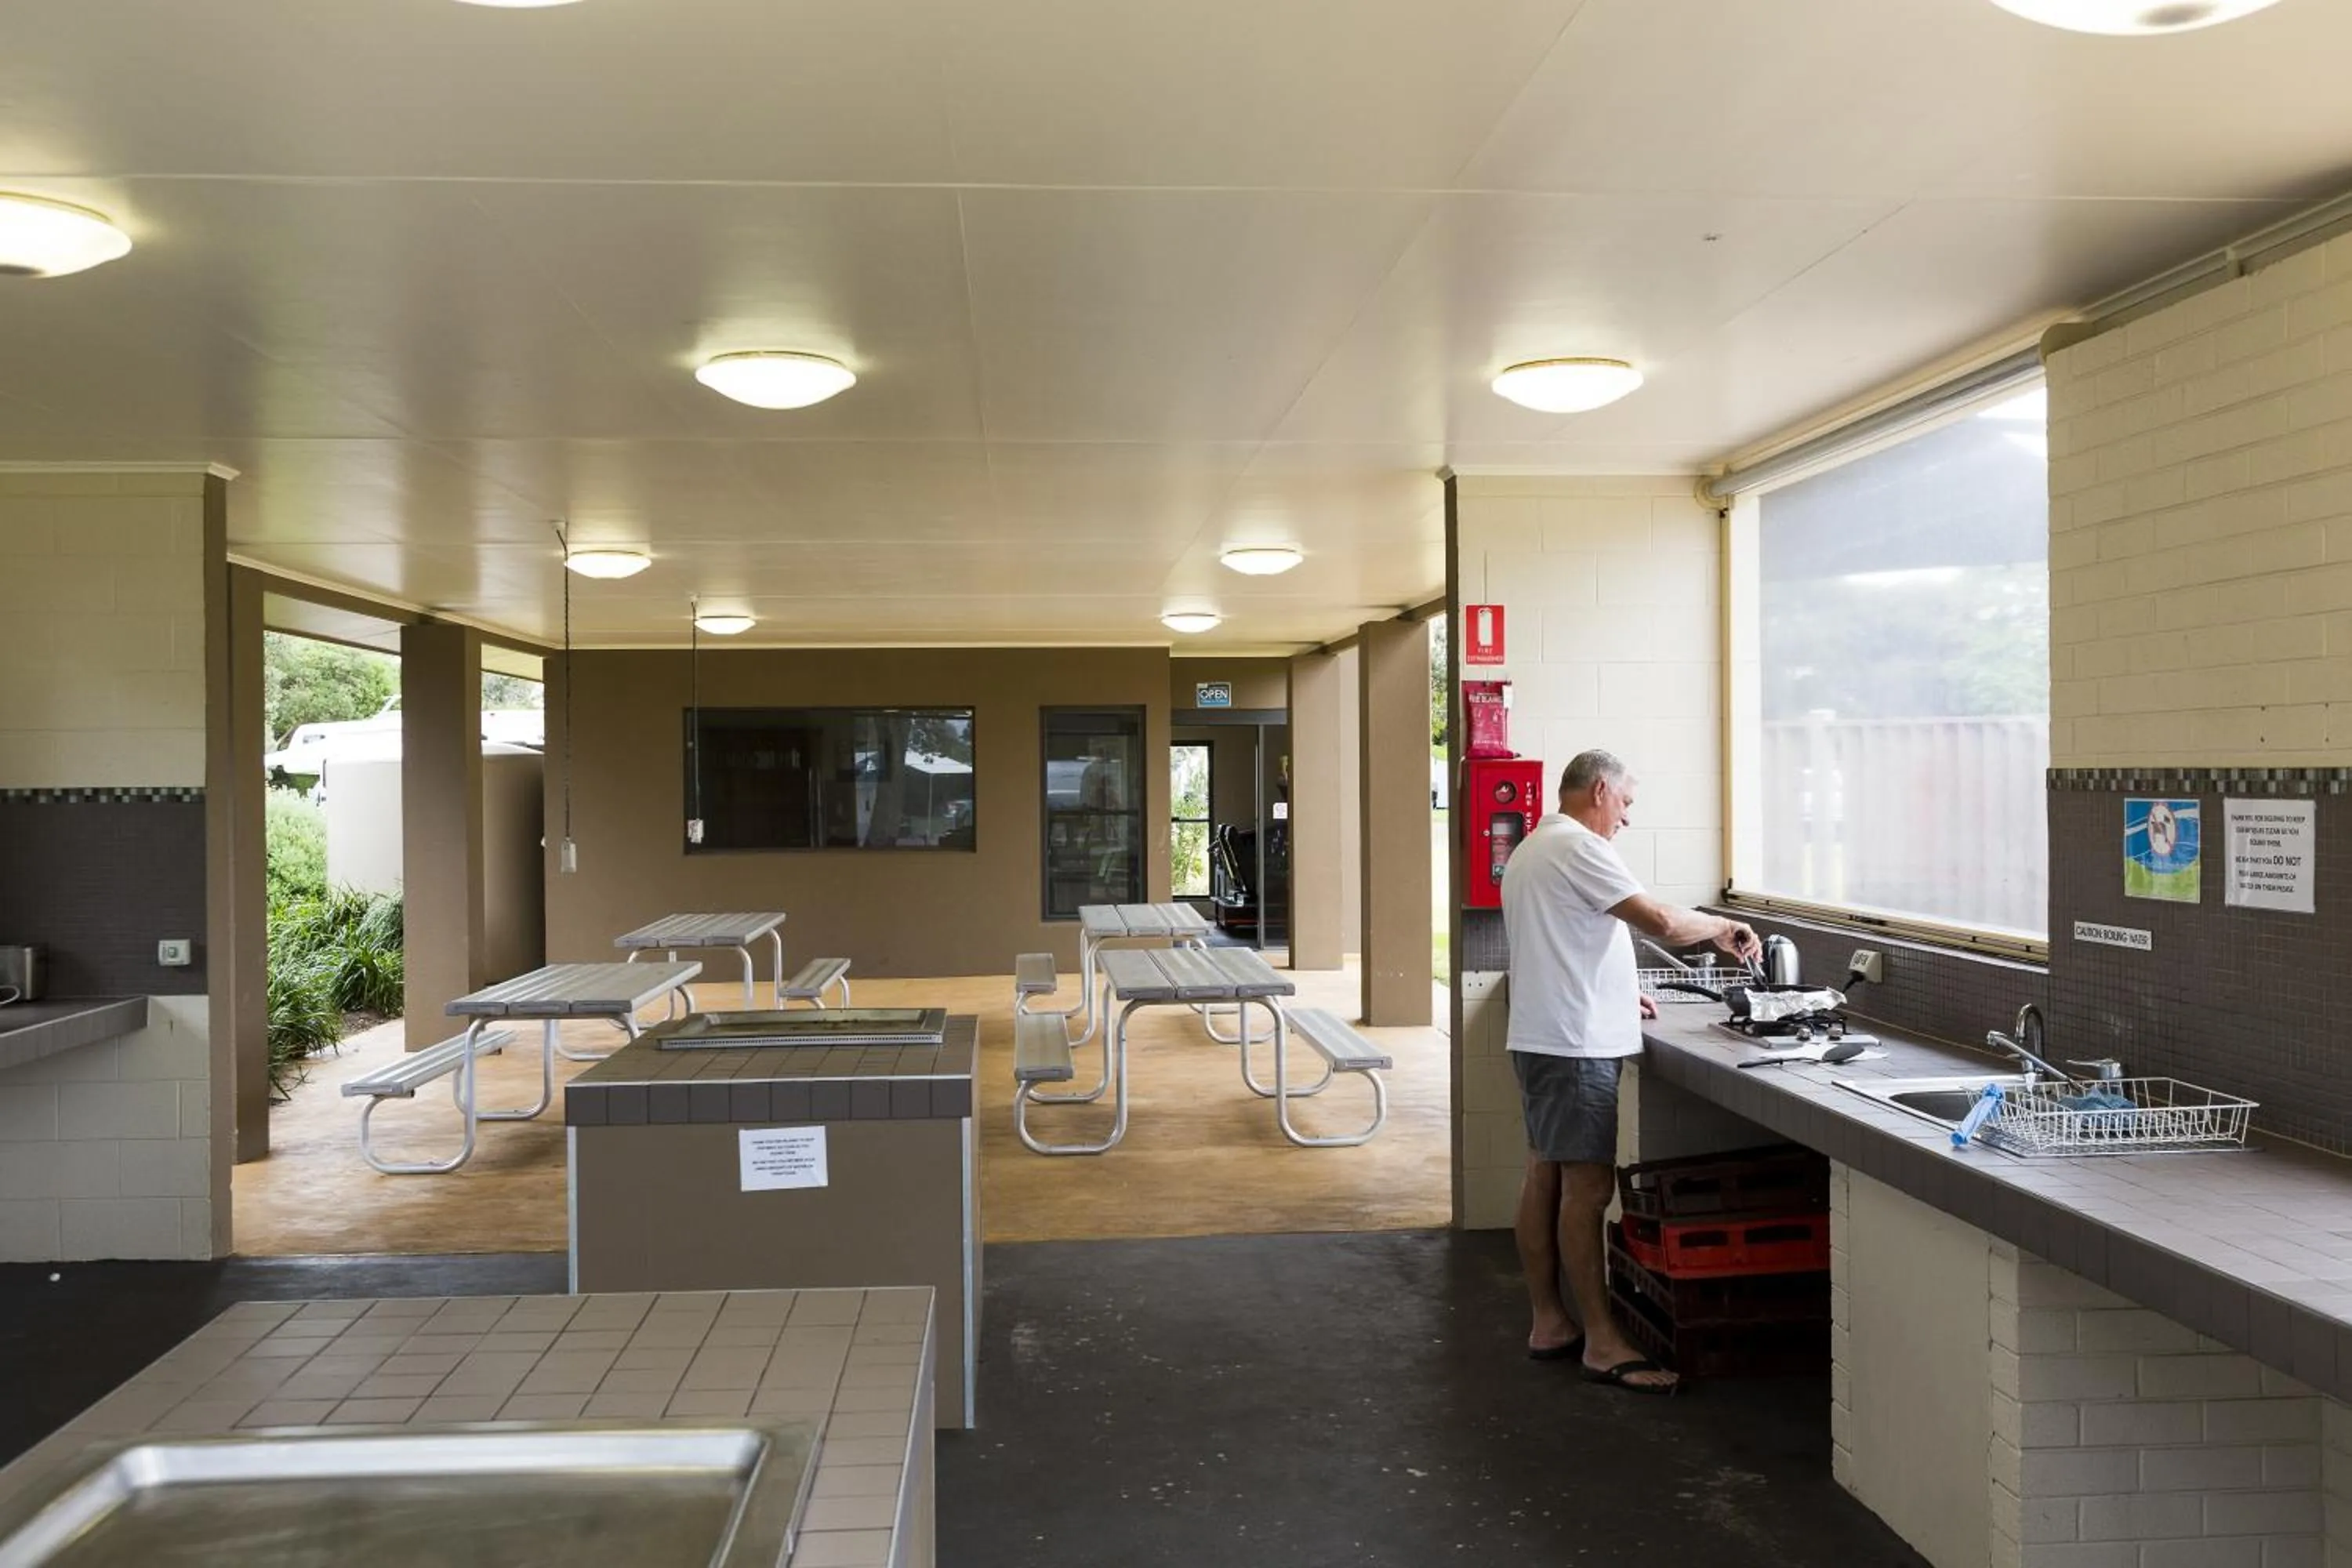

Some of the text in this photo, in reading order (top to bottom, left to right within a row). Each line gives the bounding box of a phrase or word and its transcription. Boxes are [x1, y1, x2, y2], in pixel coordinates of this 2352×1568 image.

[1200, 689, 1229, 699] OPEN
[2274, 855, 2284, 865] DO
[2285, 856, 2301, 866] NOT
[2103, 929, 2127, 942] BOILING
